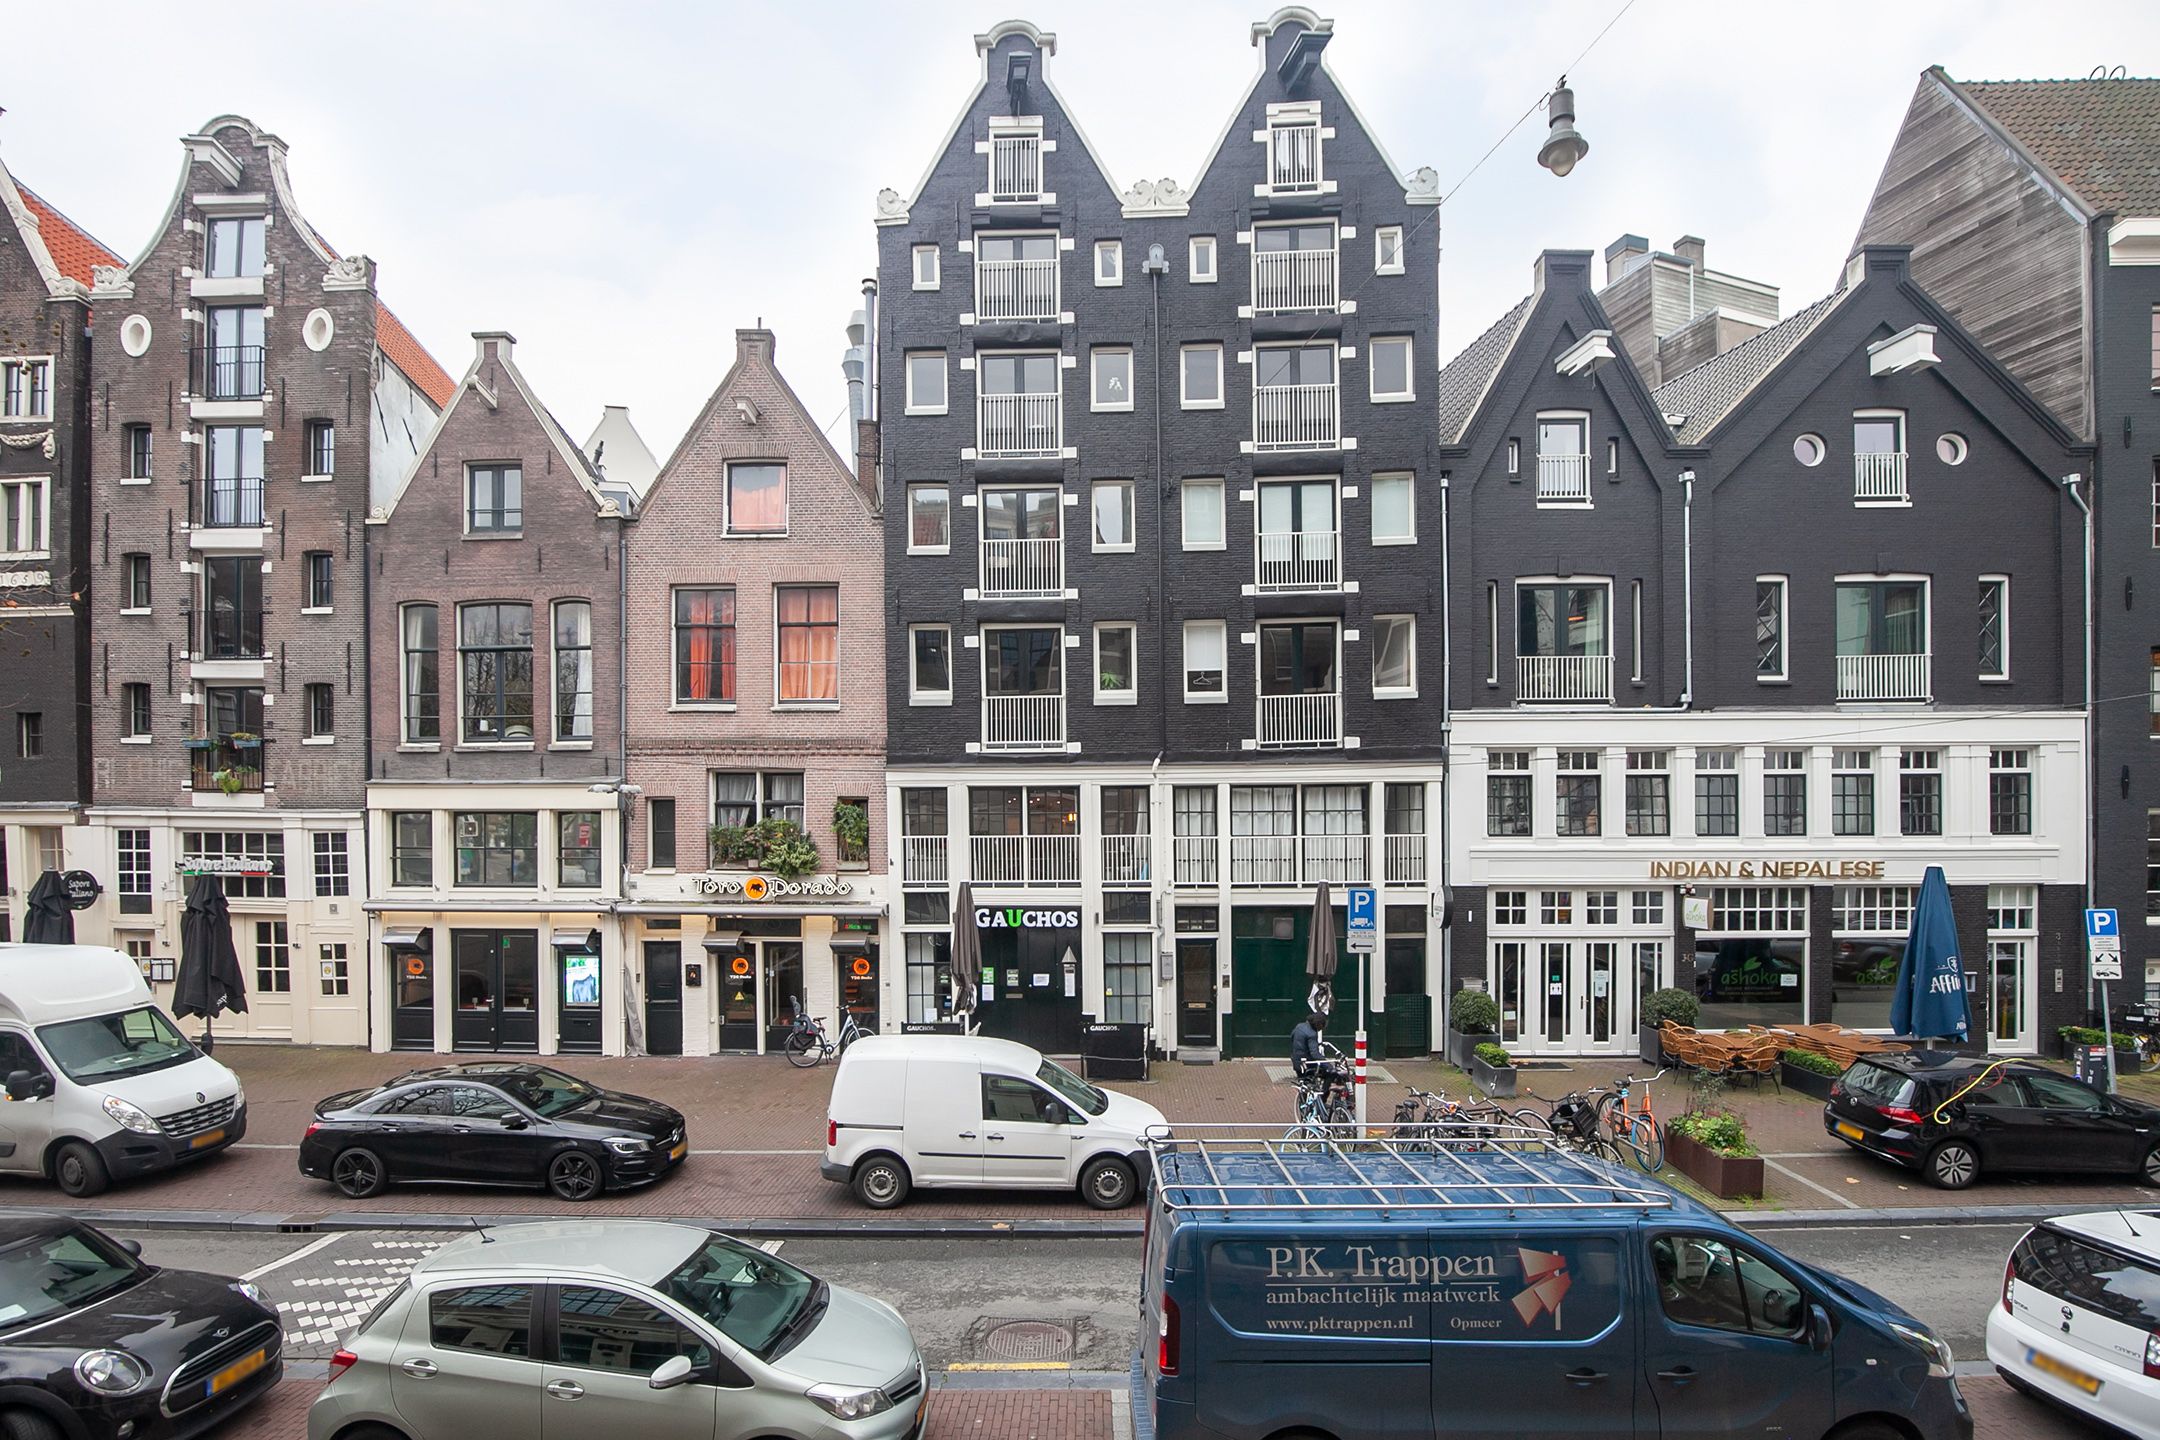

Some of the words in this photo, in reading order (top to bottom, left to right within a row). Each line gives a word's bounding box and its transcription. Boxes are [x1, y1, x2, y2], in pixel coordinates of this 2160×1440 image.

[1650, 861, 1731, 880] INDIAN
[1738, 861, 1754, 879] &
[1762, 861, 1885, 880] NEPALESE
[692, 876, 742, 895] Toro
[768, 876, 853, 897] Dorado
[1354, 891, 1371, 913] P
[974, 908, 1079, 928] GAUCHOS
[2093, 912, 2111, 934] P
[1265, 1247, 1335, 1279] P.K.
[1345, 1245, 1498, 1286] Trappen
[1265, 1286, 1397, 1308] ambachtelijk
[1402, 1286, 1501, 1304] maatwerk
[1265, 1315, 1414, 1333] www.pktrappen.nl
[1449, 1316, 1503, 1331] Opmeer
